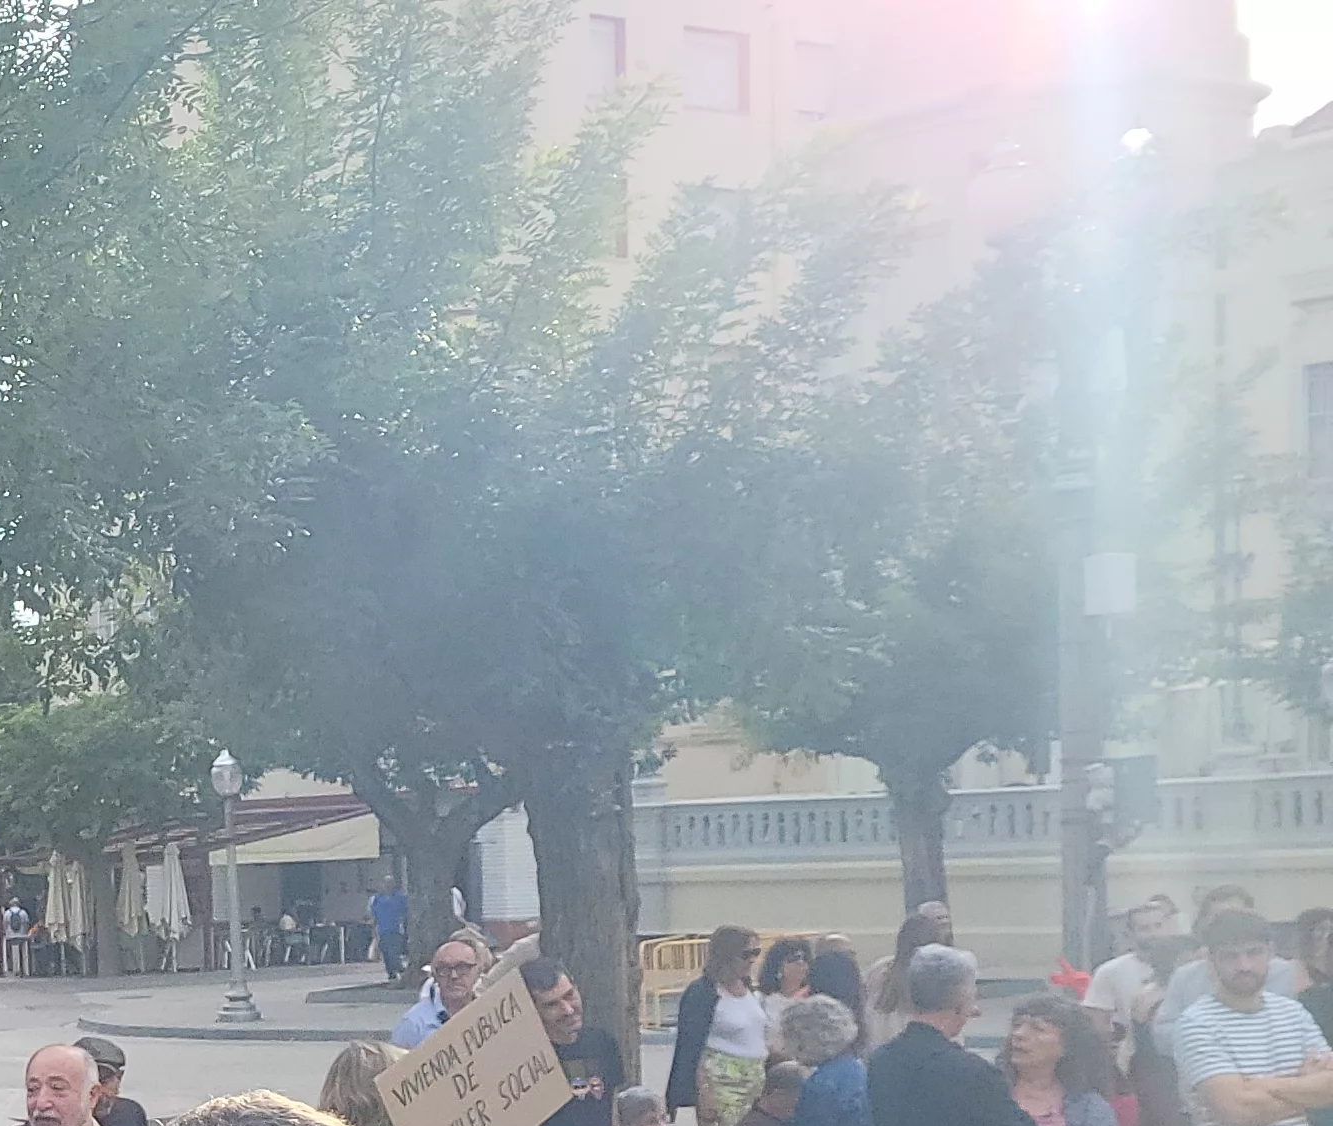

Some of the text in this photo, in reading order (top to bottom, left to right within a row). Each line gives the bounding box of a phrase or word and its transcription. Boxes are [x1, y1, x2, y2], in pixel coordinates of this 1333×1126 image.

[390, 1045, 462, 1108] VIVIENDA
[452, 1061, 480, 1100] DE
[496, 1049, 555, 1111] SOCIAL
